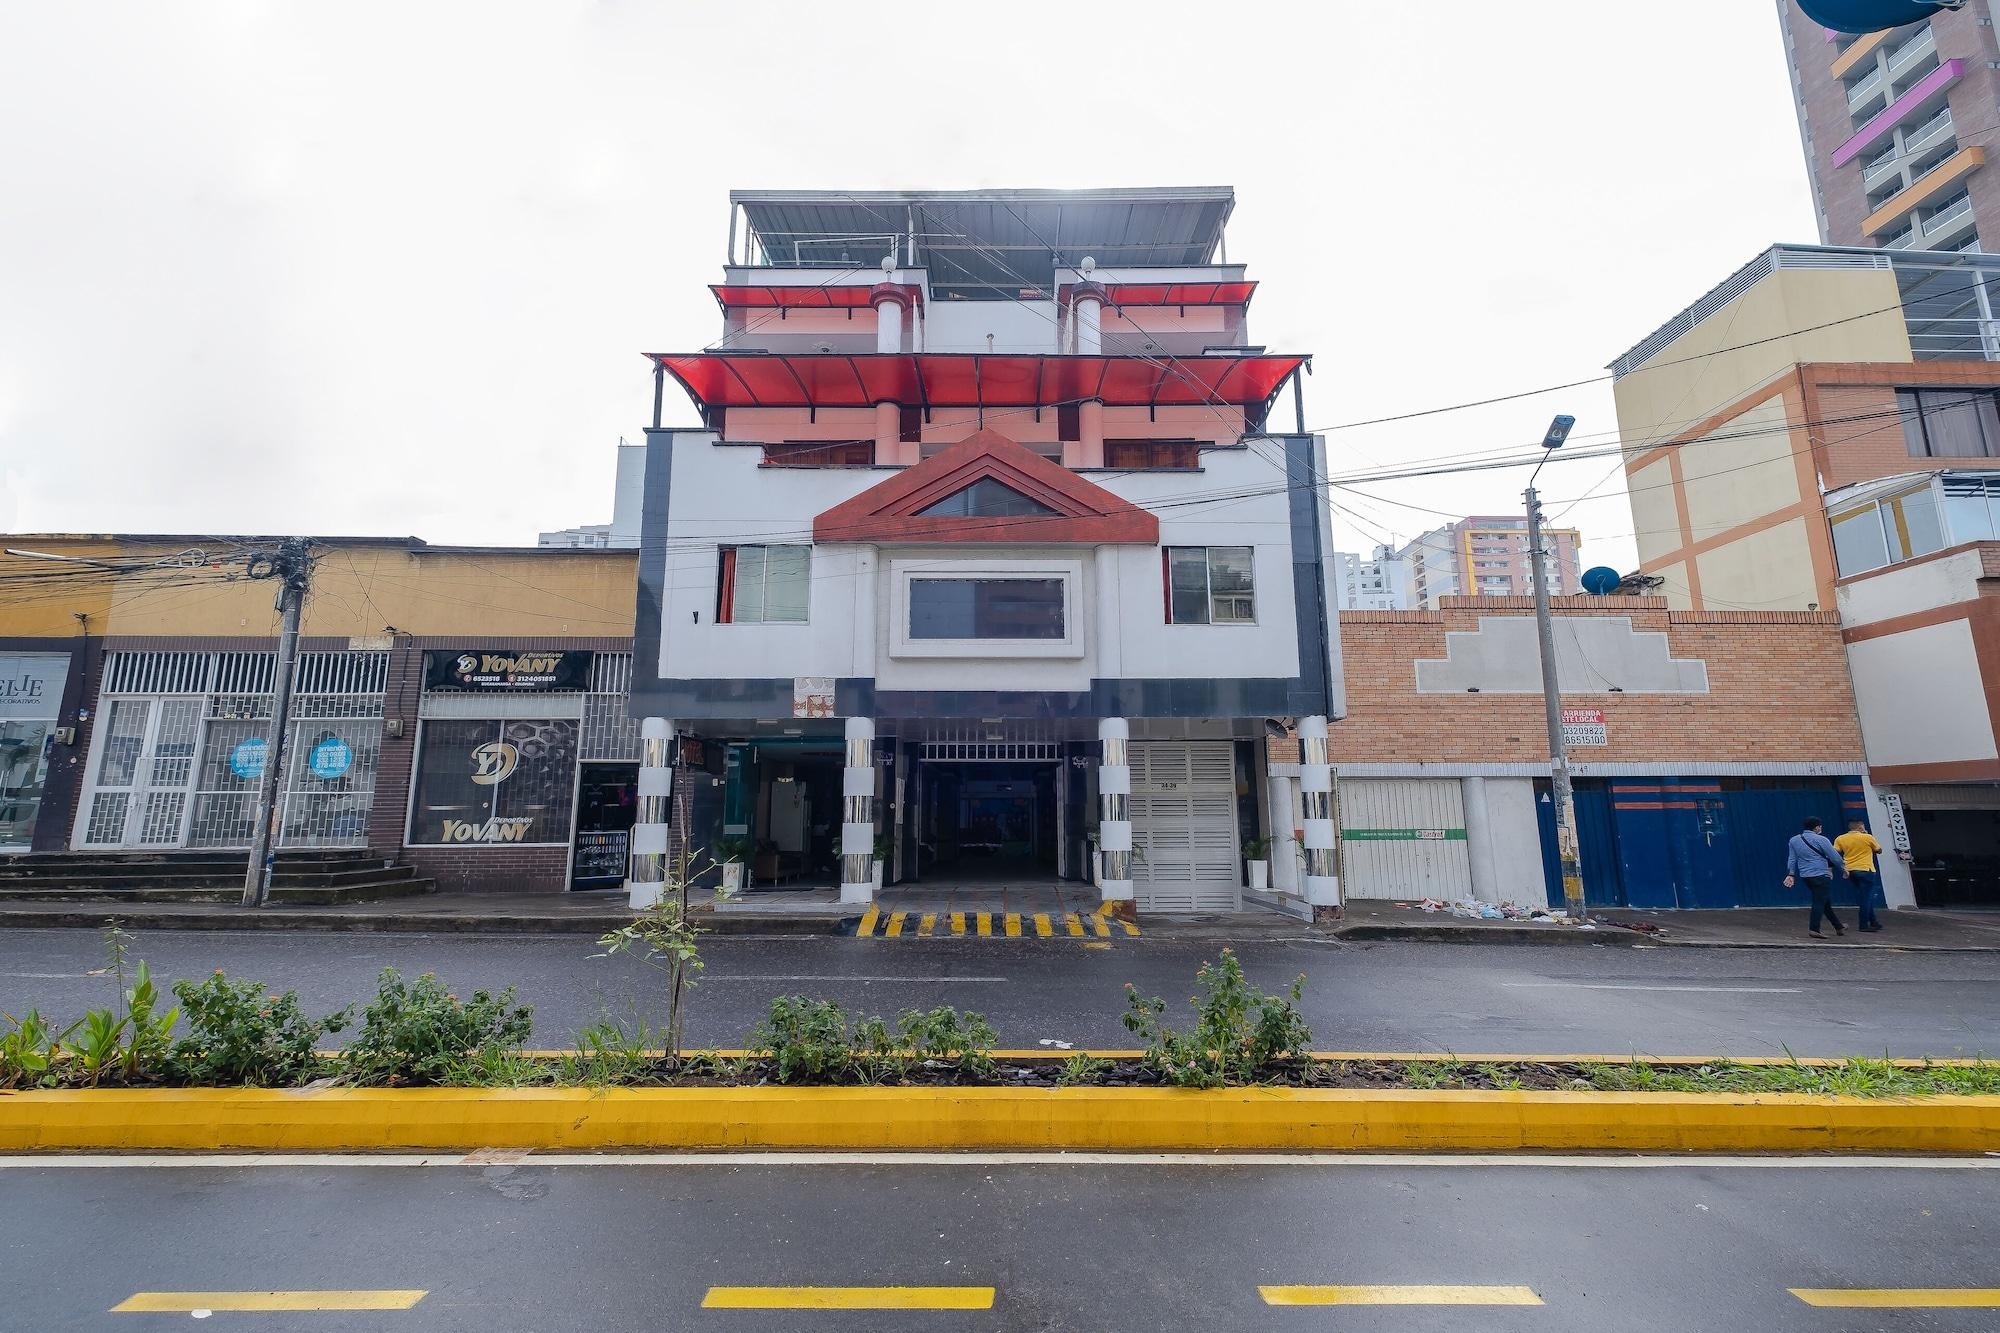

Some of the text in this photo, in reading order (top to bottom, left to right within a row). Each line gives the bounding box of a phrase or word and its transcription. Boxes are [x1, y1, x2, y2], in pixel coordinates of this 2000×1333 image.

[481, 654, 561, 673] YOVANY
[1563, 709, 1601, 717] ARRIENDA
[441, 817, 532, 842] YOVANY
[1888, 796, 1907, 847] DESAYUNOS
